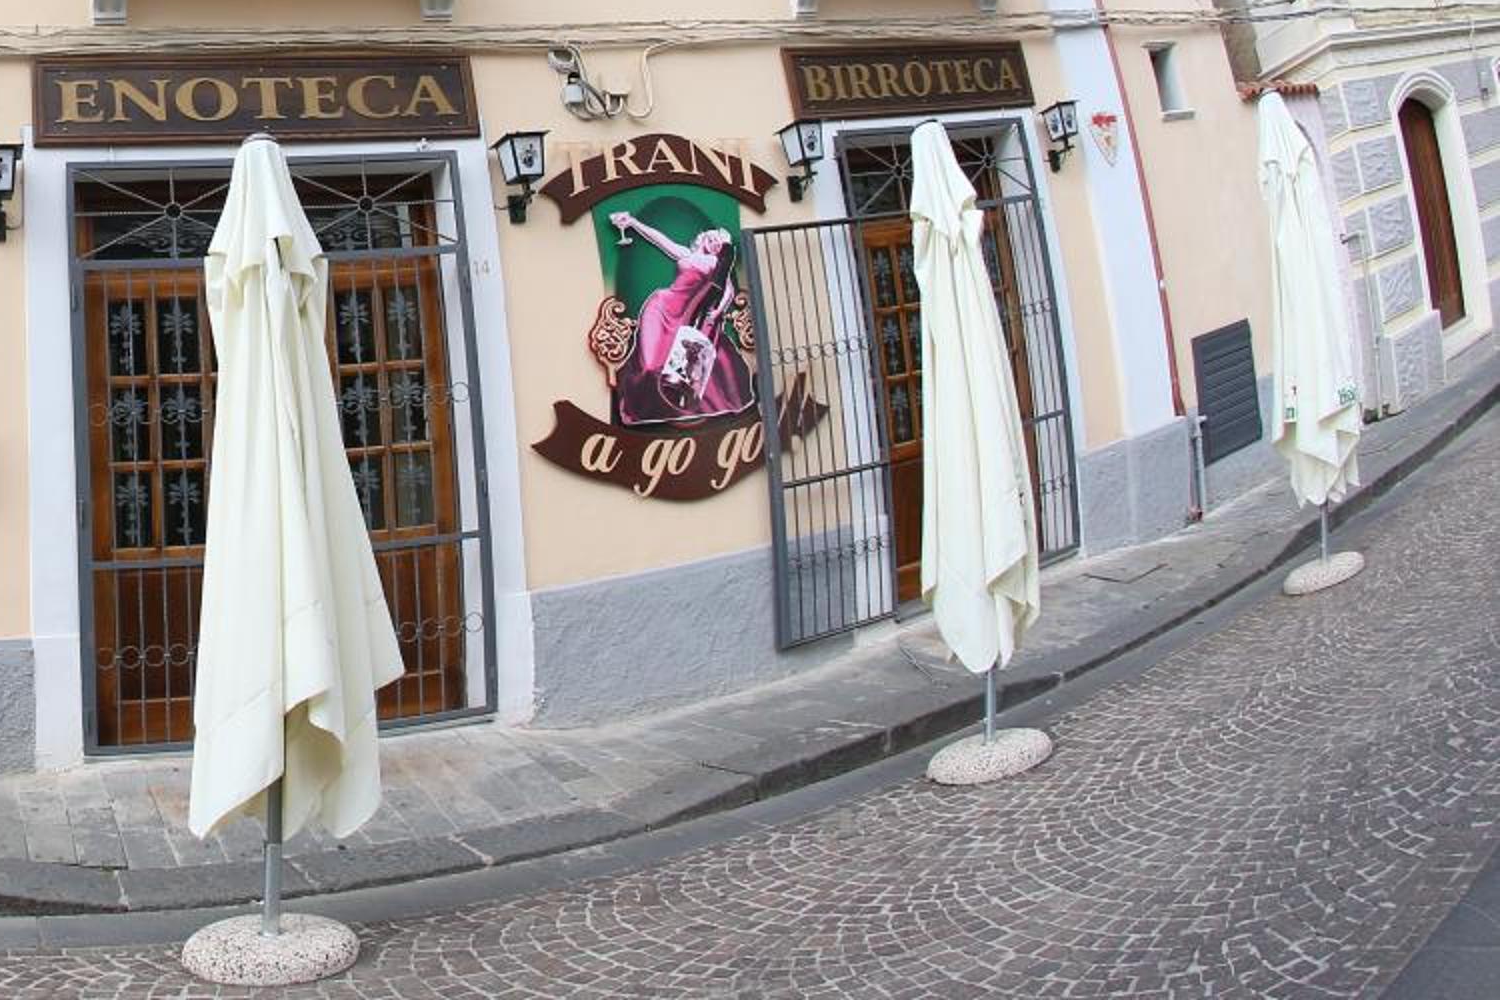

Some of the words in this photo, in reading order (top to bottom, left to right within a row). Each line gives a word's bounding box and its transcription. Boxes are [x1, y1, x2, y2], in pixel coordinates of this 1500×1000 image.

[55, 74, 459, 124] ENOTECA
[801, 56, 1023, 101] BIRROTECA
[553, 137, 762, 198] TRANI
[581, 433, 623, 473] a
[634, 437, 696, 497] go
